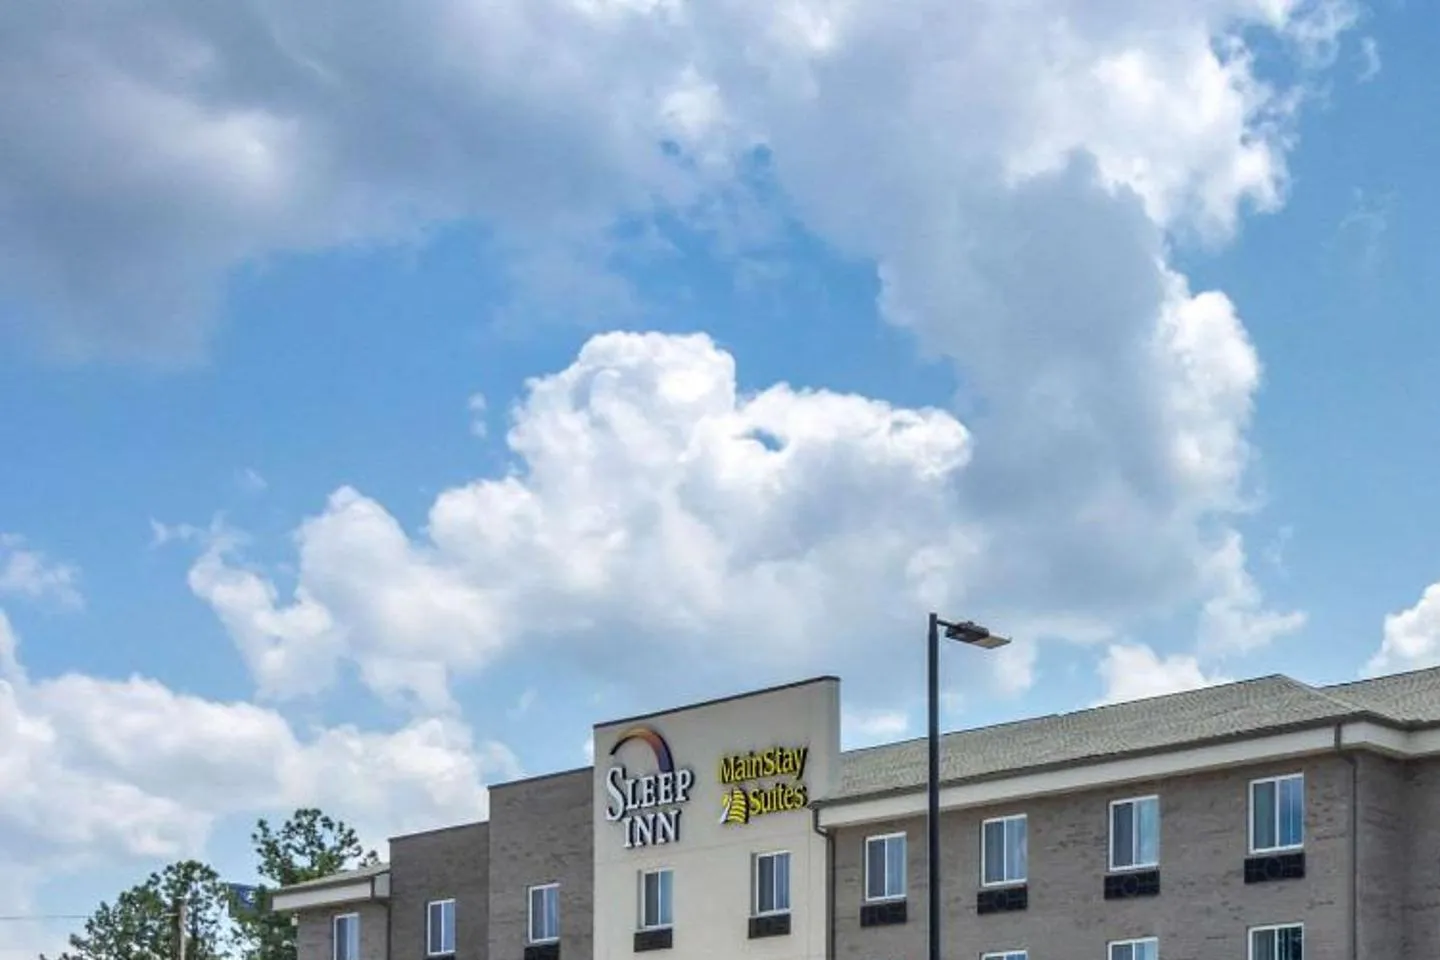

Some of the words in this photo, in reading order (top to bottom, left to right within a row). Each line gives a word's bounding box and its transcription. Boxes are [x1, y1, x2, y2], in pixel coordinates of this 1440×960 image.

[721, 747, 807, 783] MainStay
[606, 765, 693, 822] SLEEP
[749, 786, 808, 815] Suites
[623, 810, 681, 848] INN
